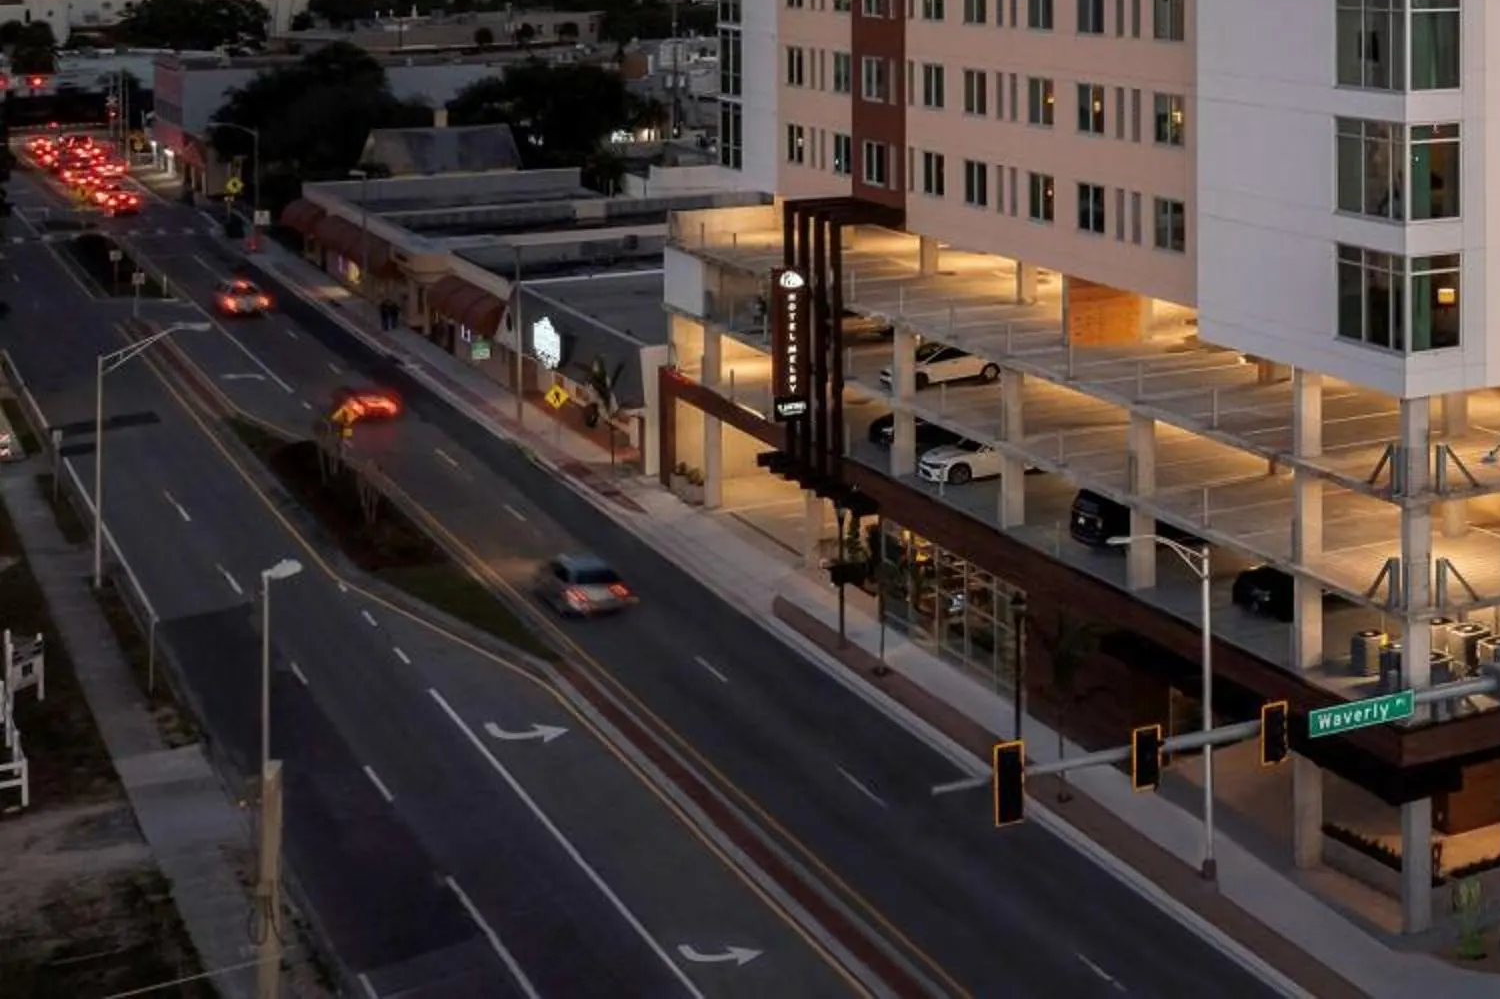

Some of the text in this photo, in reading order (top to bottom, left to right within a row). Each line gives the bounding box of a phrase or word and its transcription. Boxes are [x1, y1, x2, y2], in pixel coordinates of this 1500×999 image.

[787, 293, 797, 393] HOTEL MELBY
[1317, 702, 1390, 730] Waverly
